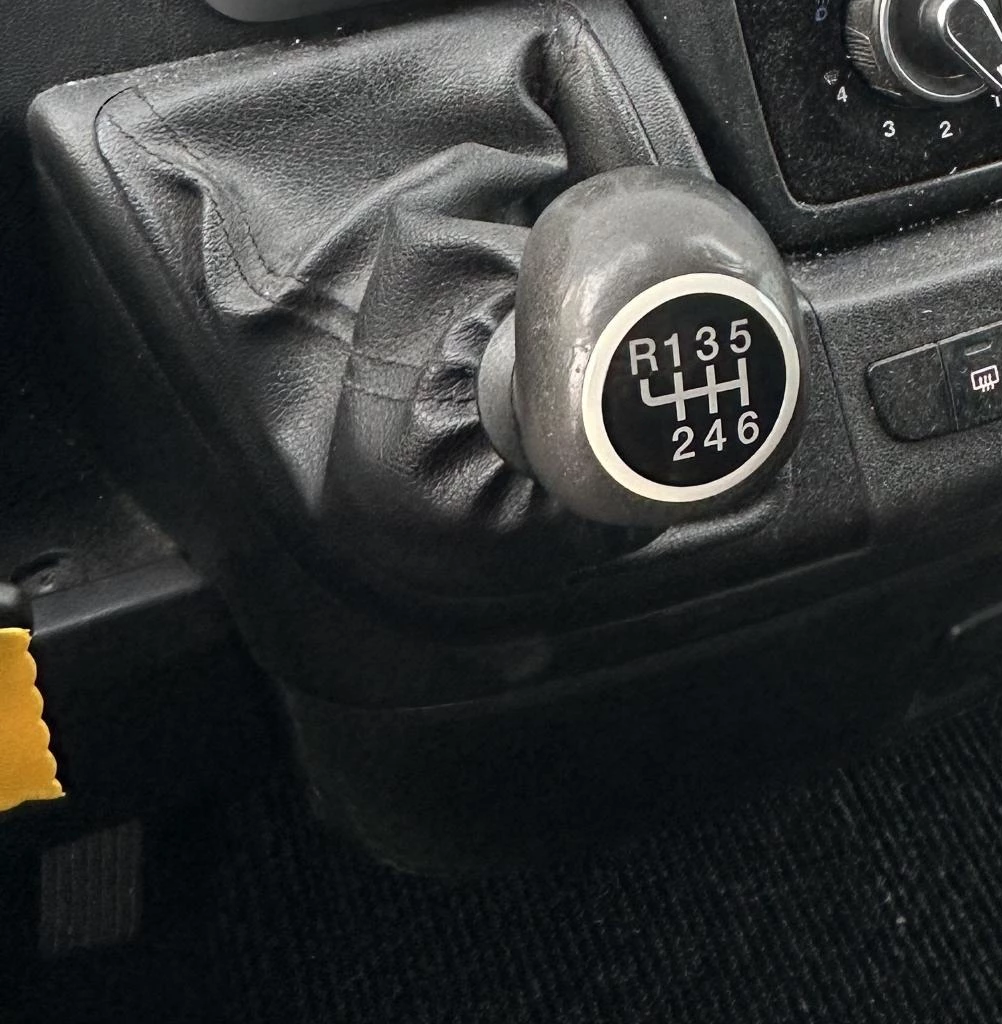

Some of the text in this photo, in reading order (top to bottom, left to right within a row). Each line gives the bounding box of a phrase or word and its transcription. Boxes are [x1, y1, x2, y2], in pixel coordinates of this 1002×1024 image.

[836, 86, 848, 103] 4
[882, 120, 896, 138] 3
[939, 120, 953, 138] 2
[628, 318, 752, 375] R 1 3 5
[671, 410, 760, 461] 2 4 6
